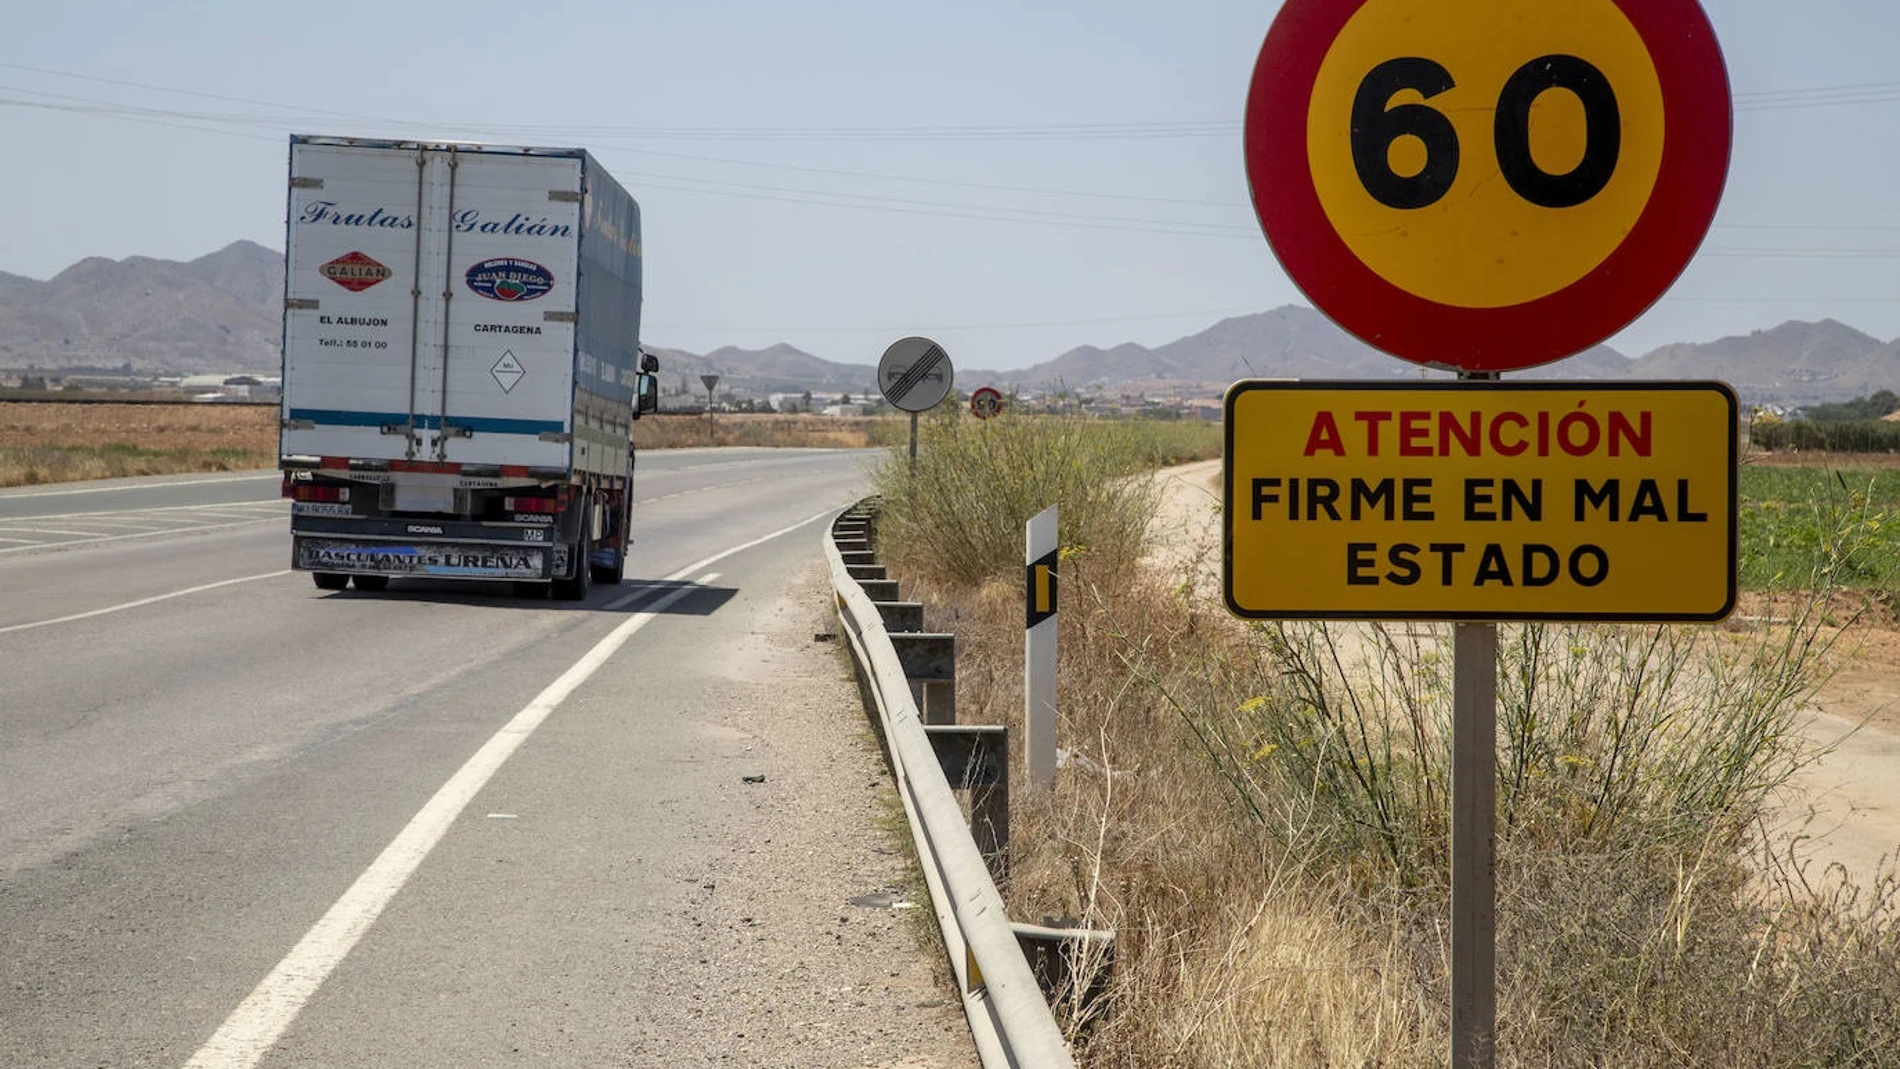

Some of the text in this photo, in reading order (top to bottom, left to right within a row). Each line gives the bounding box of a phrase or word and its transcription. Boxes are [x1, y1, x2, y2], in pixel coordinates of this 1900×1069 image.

[1350, 53, 1621, 210] 60
[300, 201, 414, 230] Frutas
[452, 208, 573, 238] Galián
[475, 272, 545, 285] JUAN DIEGO
[319, 315, 388, 327] EL ALBUJON
[473, 323, 542, 336] CARTAGENA
[374, 341, 388, 350] 00
[1303, 400, 1652, 457] ATENCIÓN
[1251, 477, 1708, 522] FIRME EN MAL
[514, 514, 554, 523] SCANIA
[407, 524, 443, 535] SCANIA
[1346, 542, 1609, 588] ESTADO
